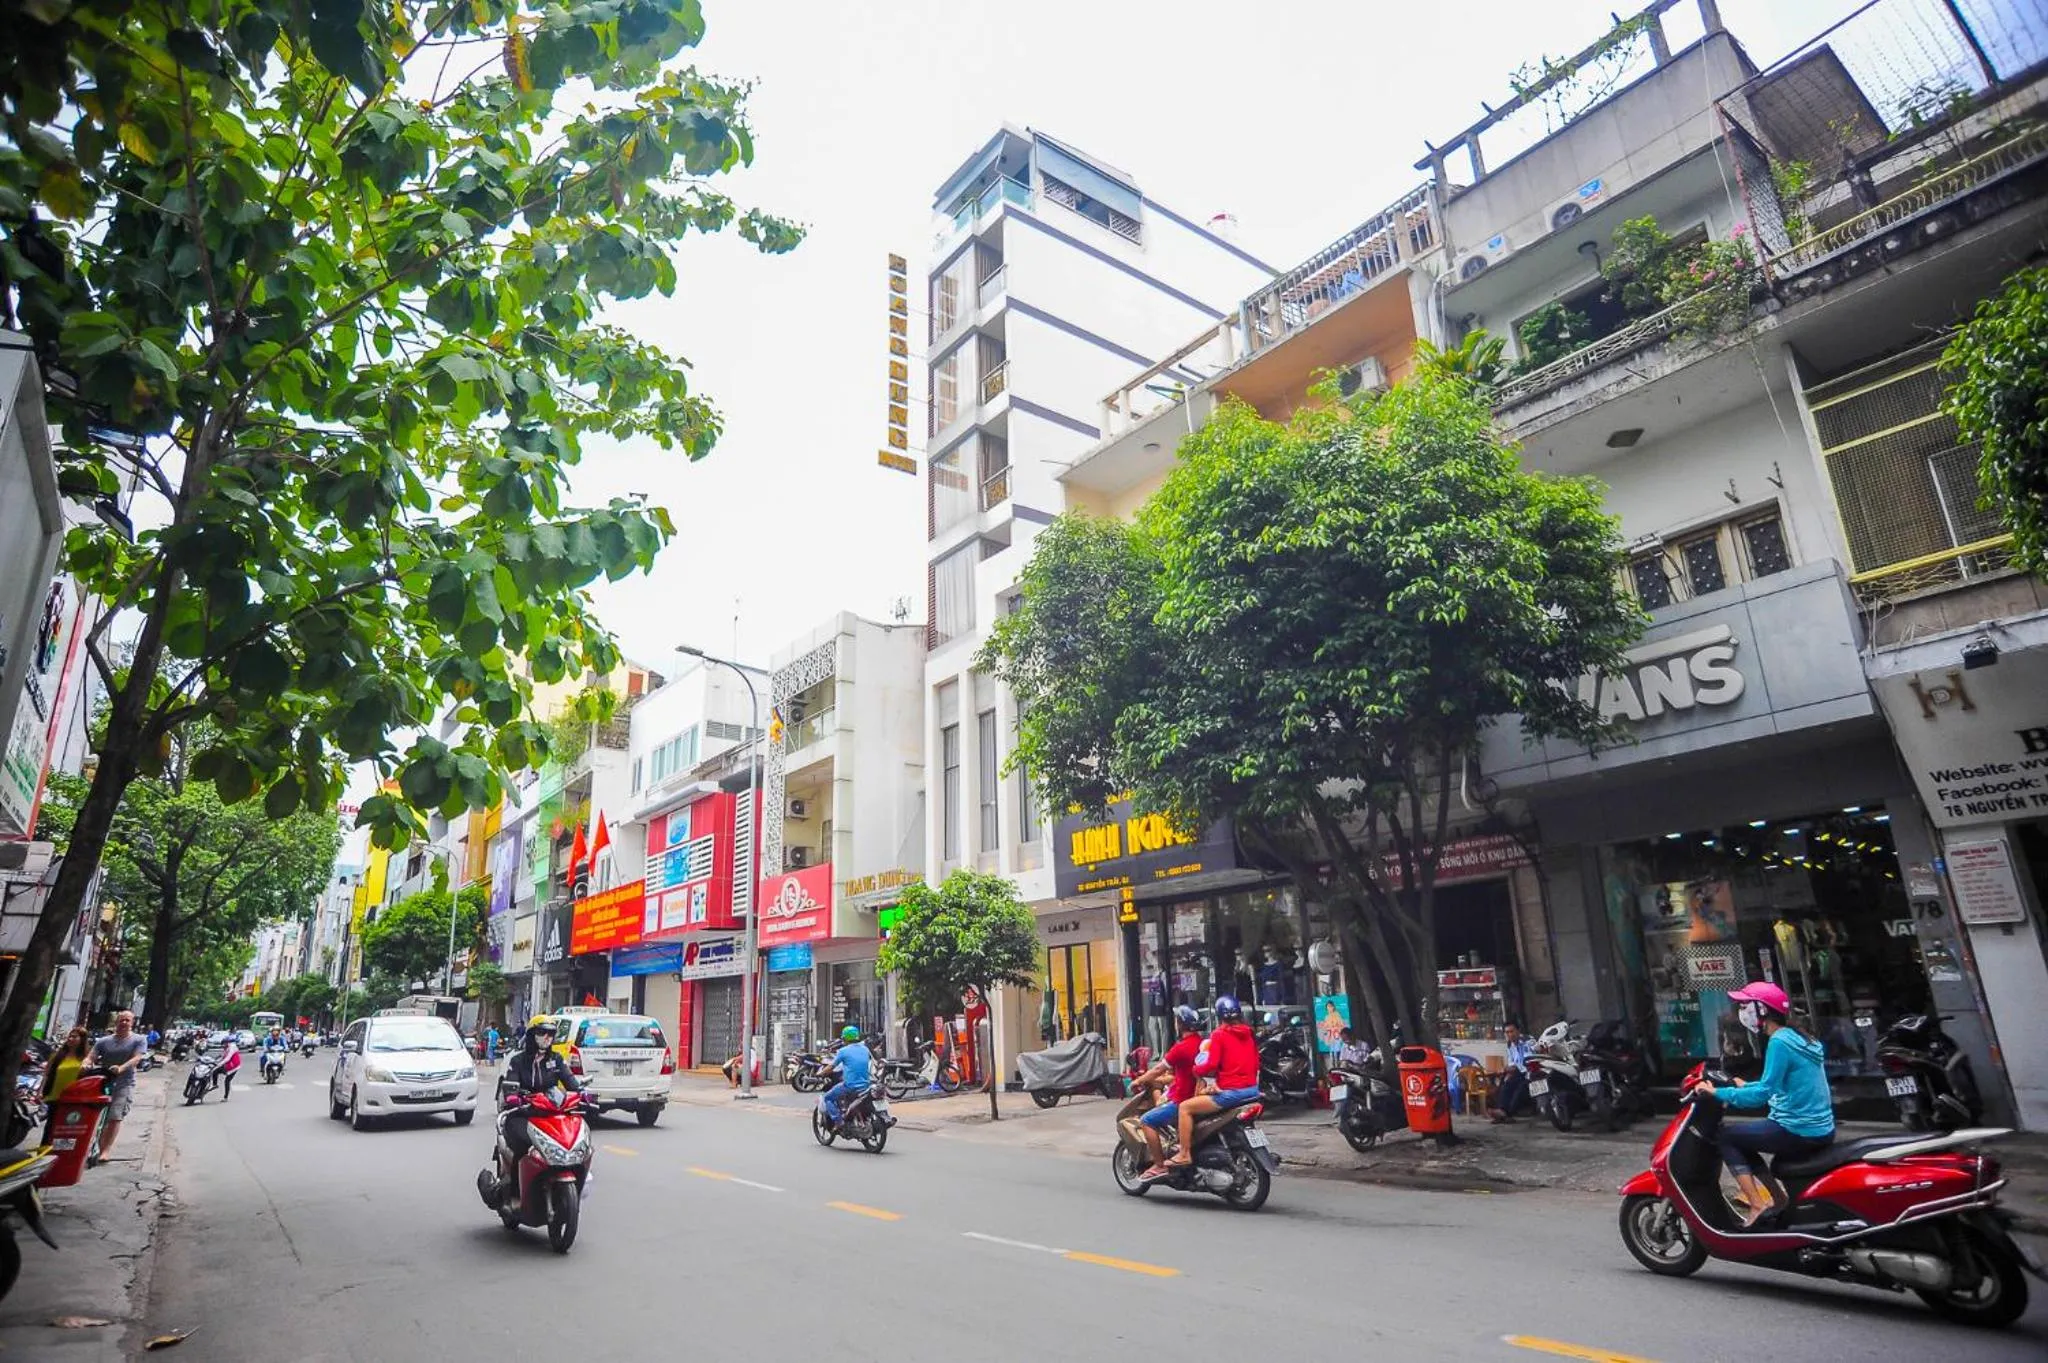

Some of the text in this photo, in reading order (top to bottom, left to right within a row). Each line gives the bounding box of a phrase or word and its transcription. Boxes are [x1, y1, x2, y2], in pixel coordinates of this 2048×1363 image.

[1929, 763, 2017, 783] Website:
[1937, 776, 2041, 802] Facebook:
[1944, 805, 1963, 817] 76
[1911, 900, 1944, 918] 78
